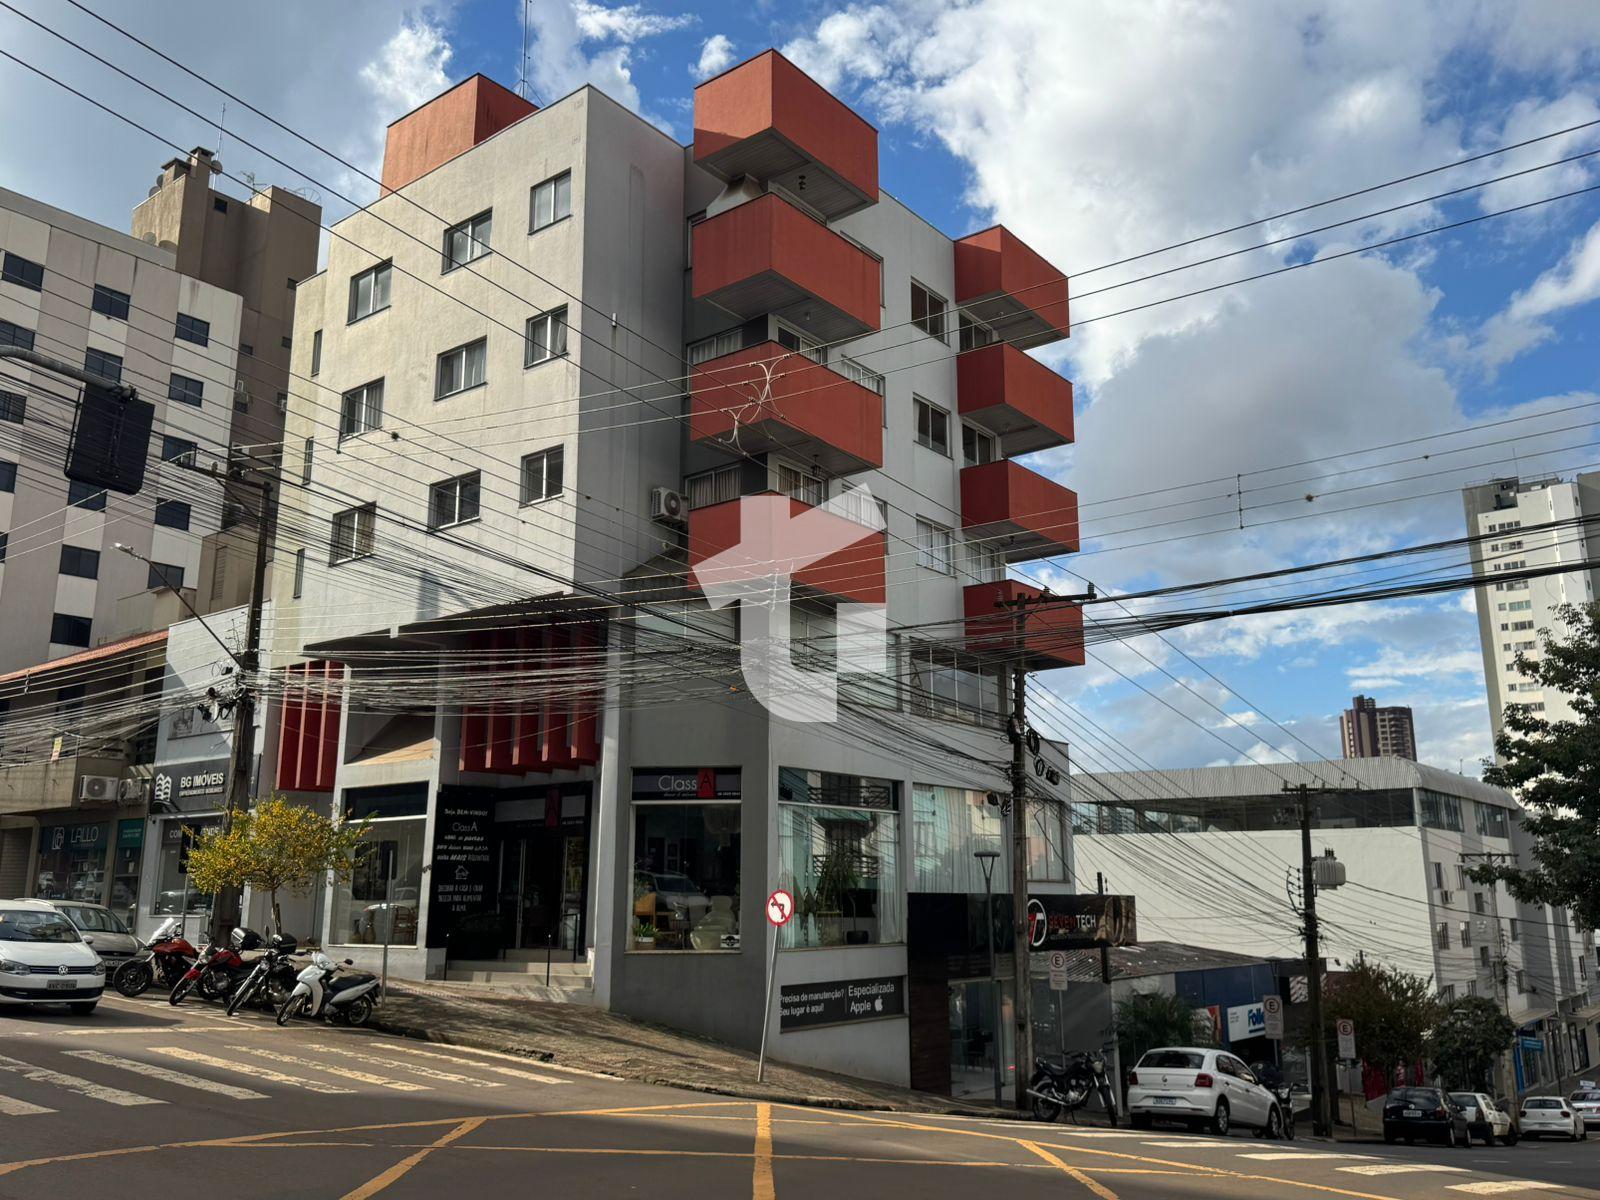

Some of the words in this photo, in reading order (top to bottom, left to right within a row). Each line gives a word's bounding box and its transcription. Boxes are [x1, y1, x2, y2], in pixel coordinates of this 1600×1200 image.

[180, 776, 192, 788] BG
[193, 770, 224, 786] IMÓVEIS
[658, 775, 697, 791] Class
[779, 993, 800, 1004] Precisa
[800, 992, 808, 1002] de
[808, 988, 845, 1001] manutenção?
[848, 980, 895, 998] Especializada
[779, 1007, 790, 1017] Seu
[790, 1006, 806, 1017] lugar
[850, 999, 872, 1014] Apple
